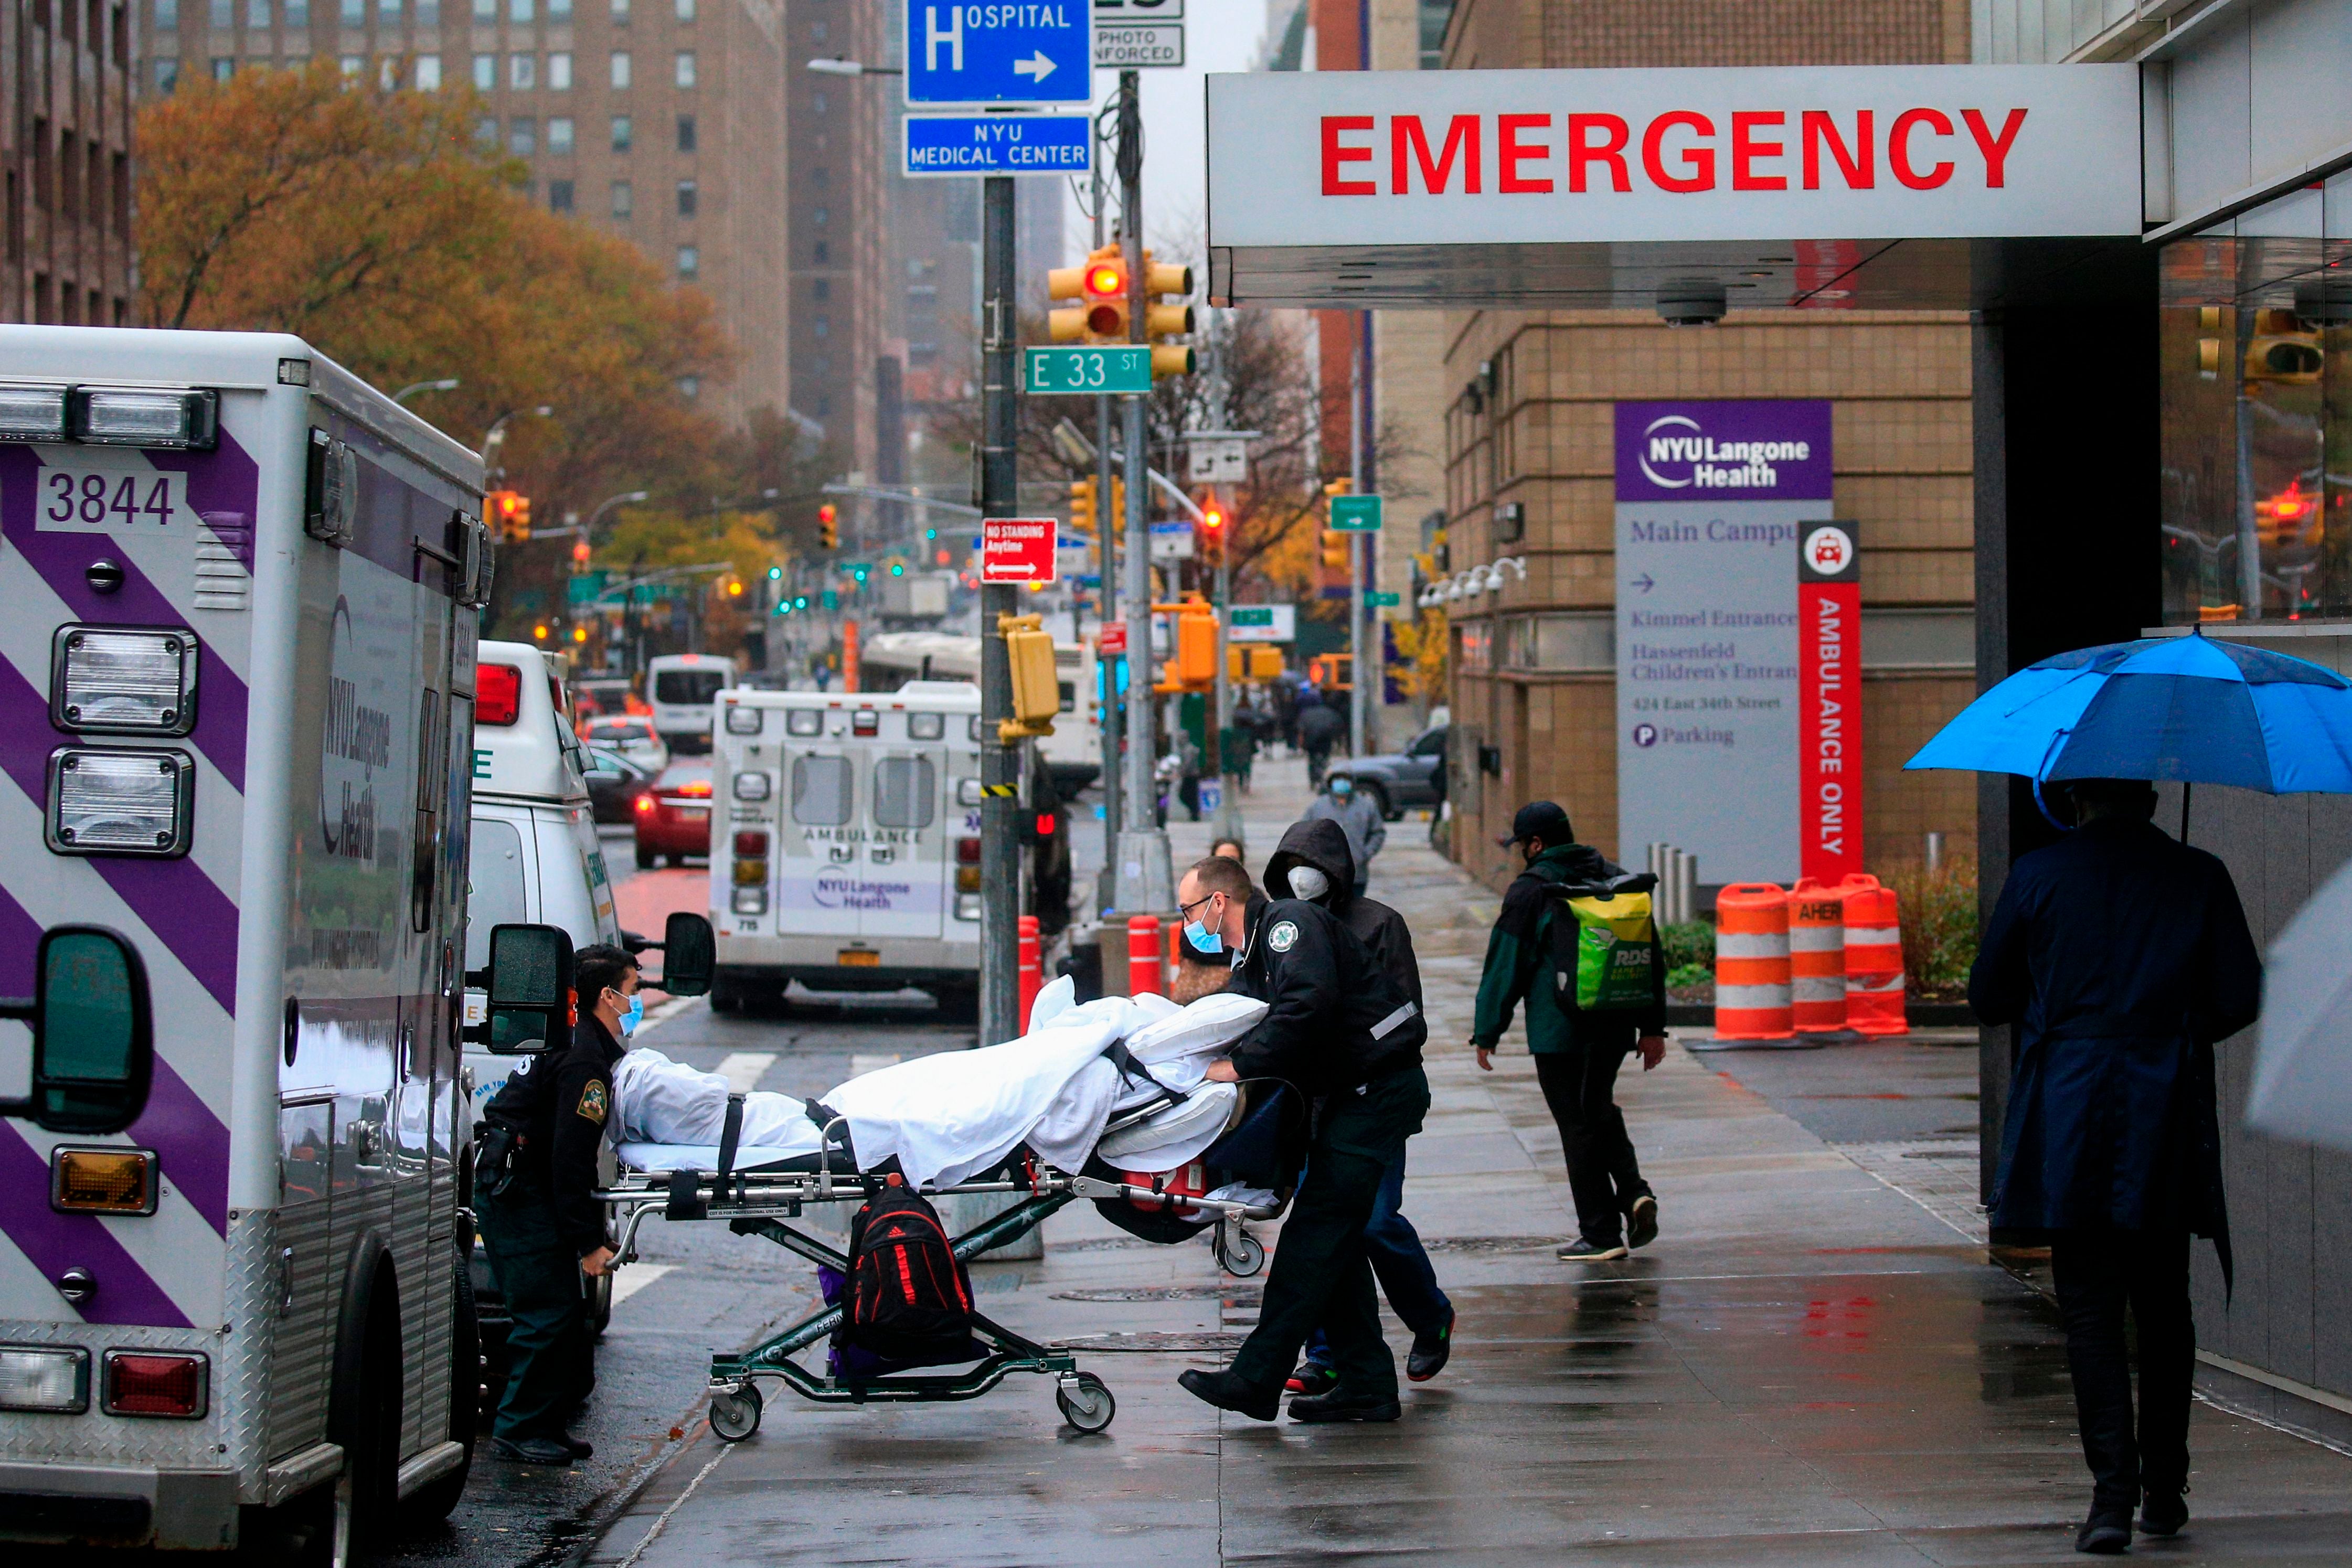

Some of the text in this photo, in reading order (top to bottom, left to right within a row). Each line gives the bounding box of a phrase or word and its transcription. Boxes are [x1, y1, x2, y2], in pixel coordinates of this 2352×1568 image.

[1098, 31, 1156, 43] PHOTO
[1094, 46, 1174, 59] NFORCED
[974, 124, 1023, 142] NYU
[911, 145, 1085, 165] MEDICAL CENTER
[1319, 107, 2029, 197] EMERGENCY
[1034, 354, 1137, 387] E 33 ST
[1694, 464, 1777, 488] Health
[48, 473, 175, 525] 3844
[986, 525, 1045, 538] NO STANDING
[1631, 519, 1798, 547] Main Campu
[986, 539, 1023, 554] Anytime
[1631, 610, 1707, 627] Kimmel
[1736, 696, 1781, 710] Street
[1818, 597, 1843, 856] AMBULANCE ONLY
[1662, 727, 1734, 746] Parking
[341, 781, 374, 860] Health
[804, 829, 922, 844] AMBULANCE
[844, 894, 891, 910] Health
[1614, 948, 1652, 966] RDS
[475, 1083, 491, 1097] NEW
[815, 1310, 843, 1333] FERN
